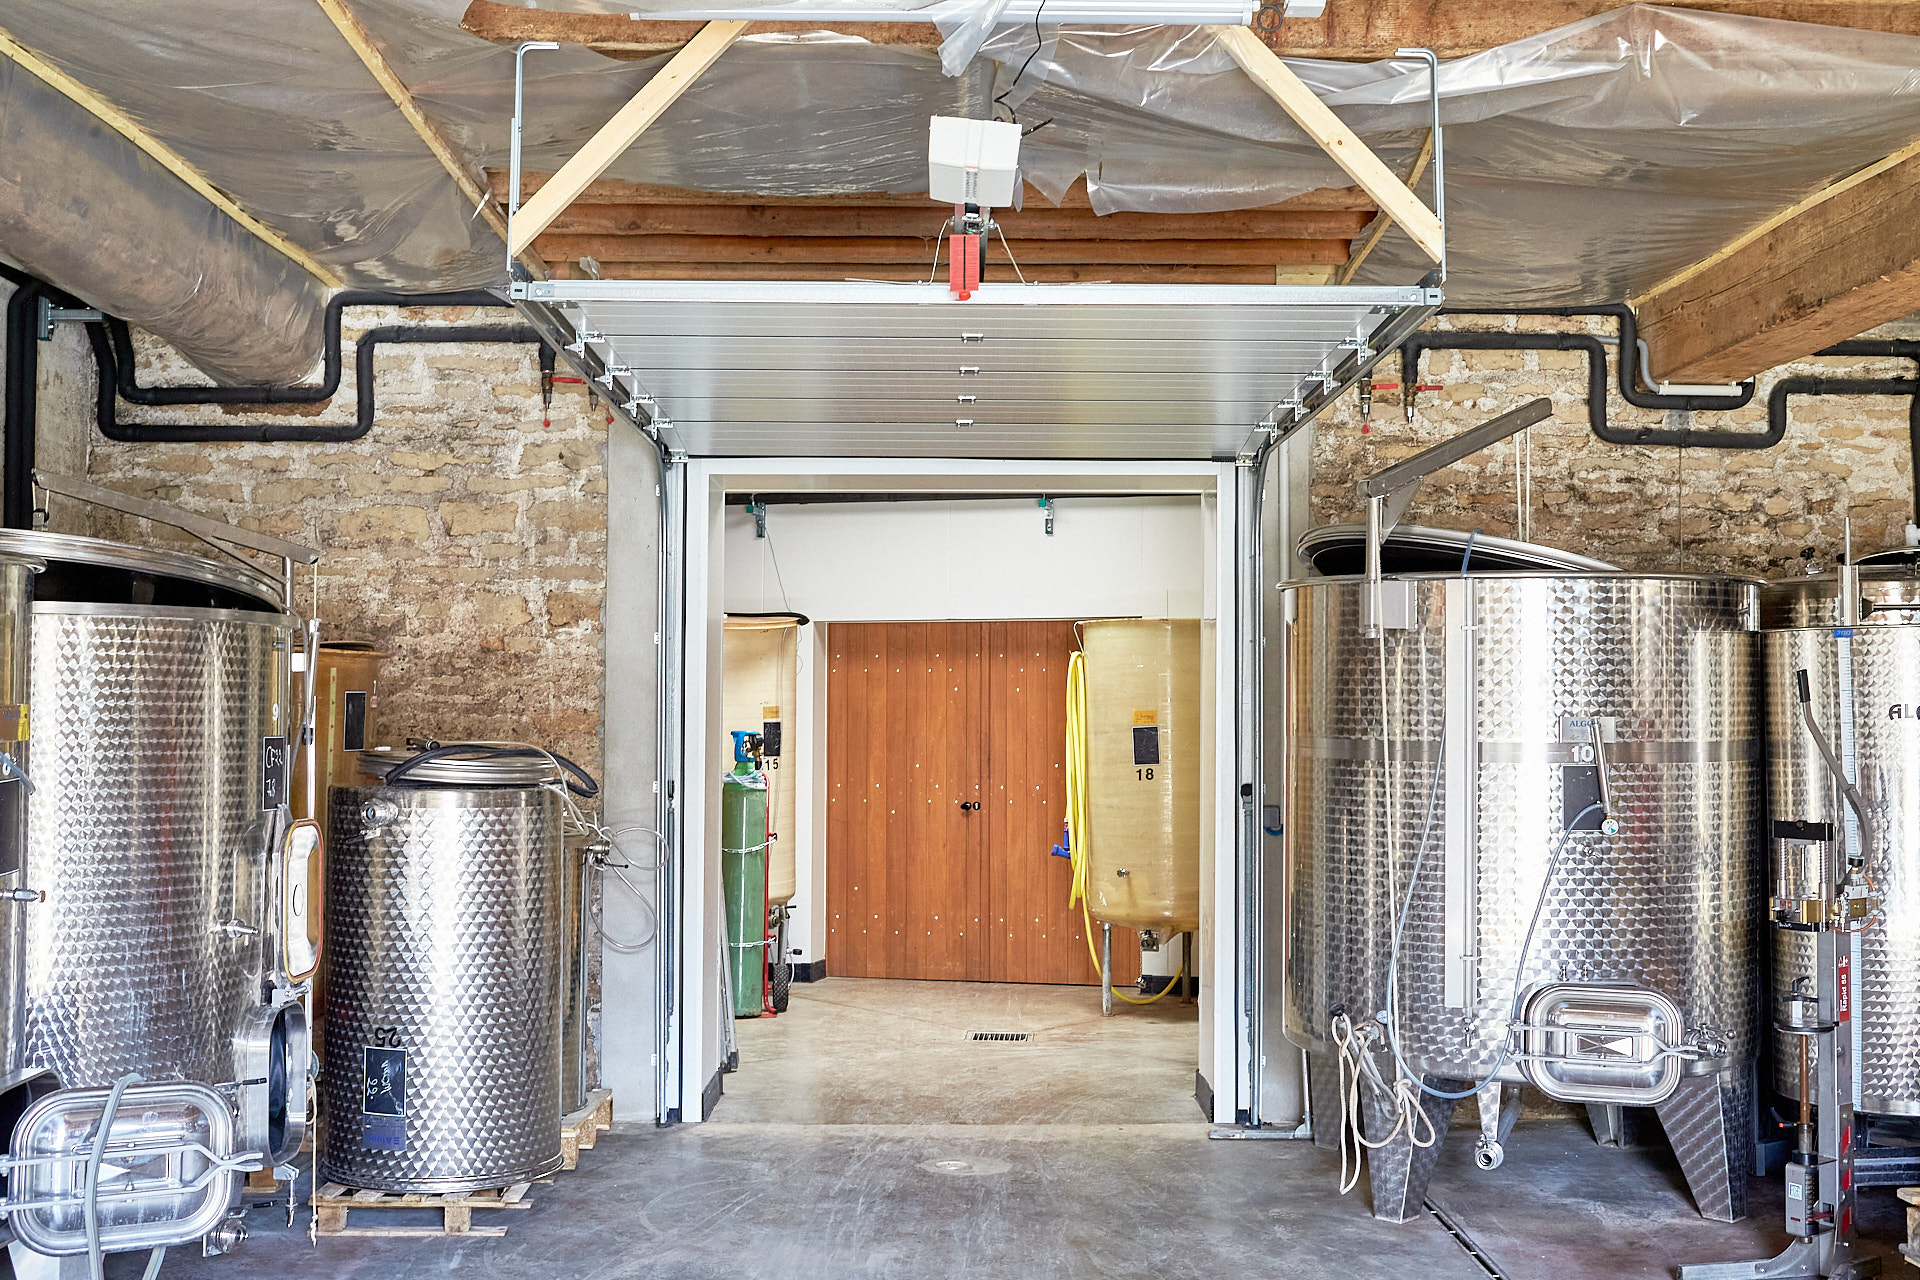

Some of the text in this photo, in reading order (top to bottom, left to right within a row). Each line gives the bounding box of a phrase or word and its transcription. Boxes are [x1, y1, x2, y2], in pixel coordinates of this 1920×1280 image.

[272, 703, 279, 722] 9
[1888, 703, 1920, 721] AL
[1569, 720, 1594, 728] ALGO
[1571, 745, 1594, 763] 10
[764, 757, 779, 771] 15
[1135, 767, 1155, 781] 18
[374, 1027, 401, 1048] 25
